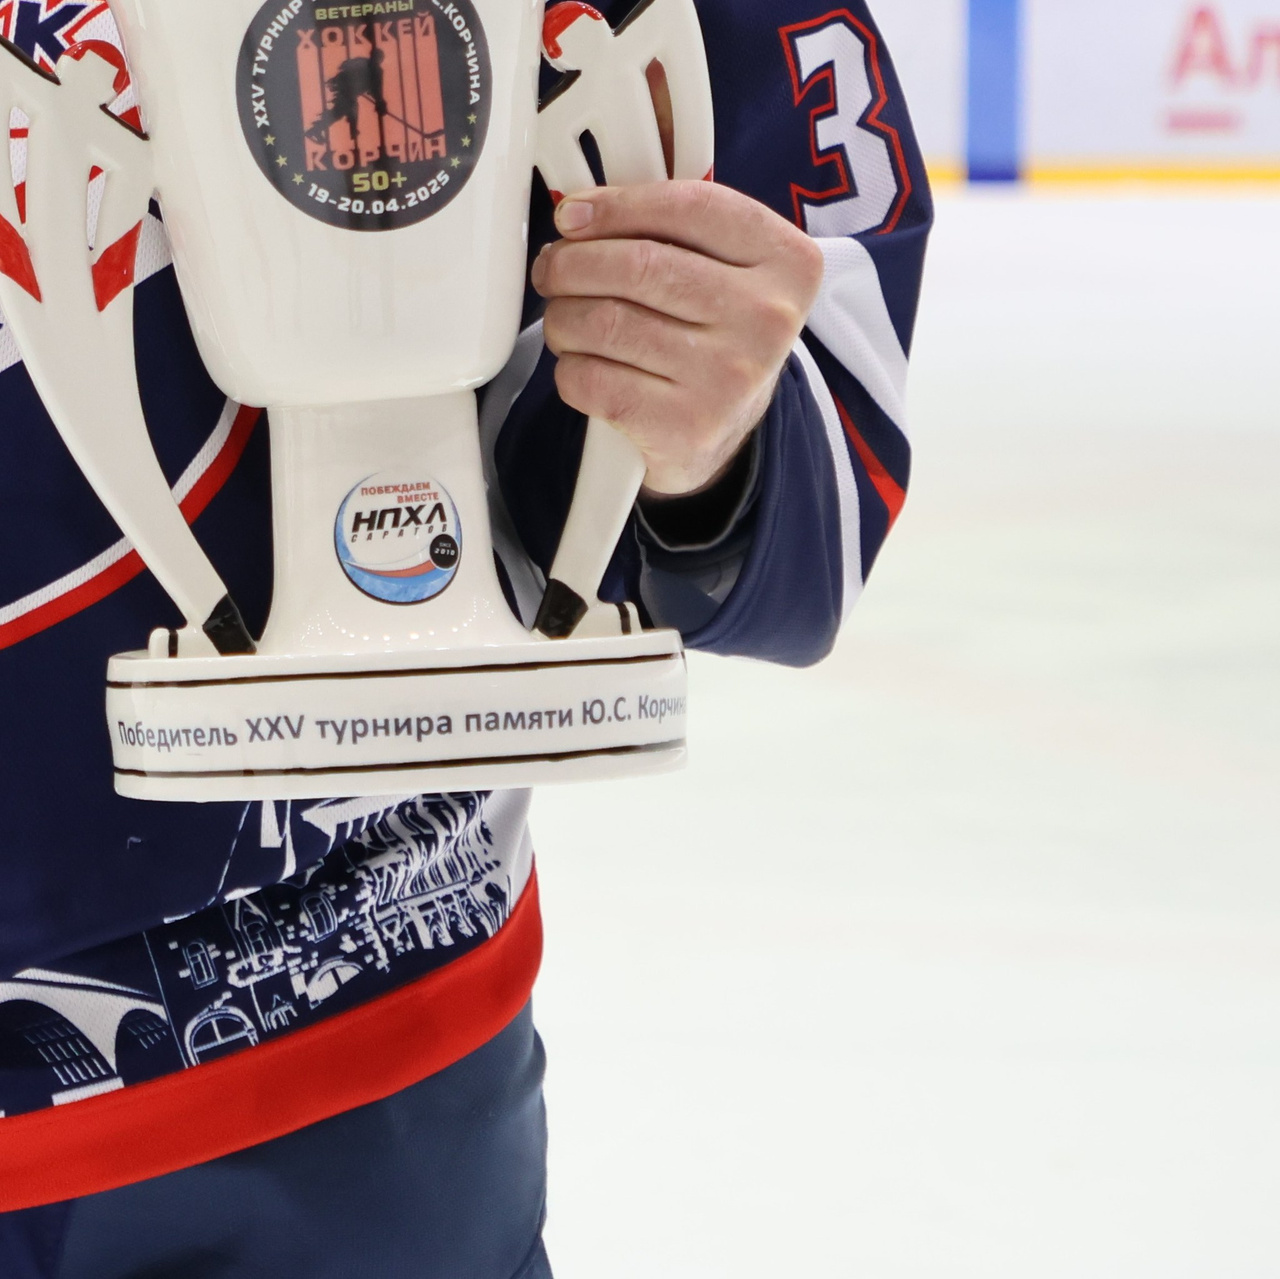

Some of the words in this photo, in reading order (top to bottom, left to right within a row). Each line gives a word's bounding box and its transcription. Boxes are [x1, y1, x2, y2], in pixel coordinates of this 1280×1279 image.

[315, 0, 414, 21] ВЕТЕРАНЫ
[250, 84, 271, 129] XXV
[307, 169, 450, 215] 19-20.04.2025
[352, 170, 408, 193] 50+
[361, 481, 431, 497] ПОБЕЖДАЕМ
[396, 491, 439, 504] ВМЕСТЕ
[351, 502, 447, 533] НПХЛ
[351, 523, 448, 543] САРАТОВ
[118, 720, 238, 753] Победитель
[245, 714, 306, 743] XXV
[315, 714, 453, 746] турнира
[465, 707, 573, 733] памяти
[582, 696, 632, 725] Ю.С.
